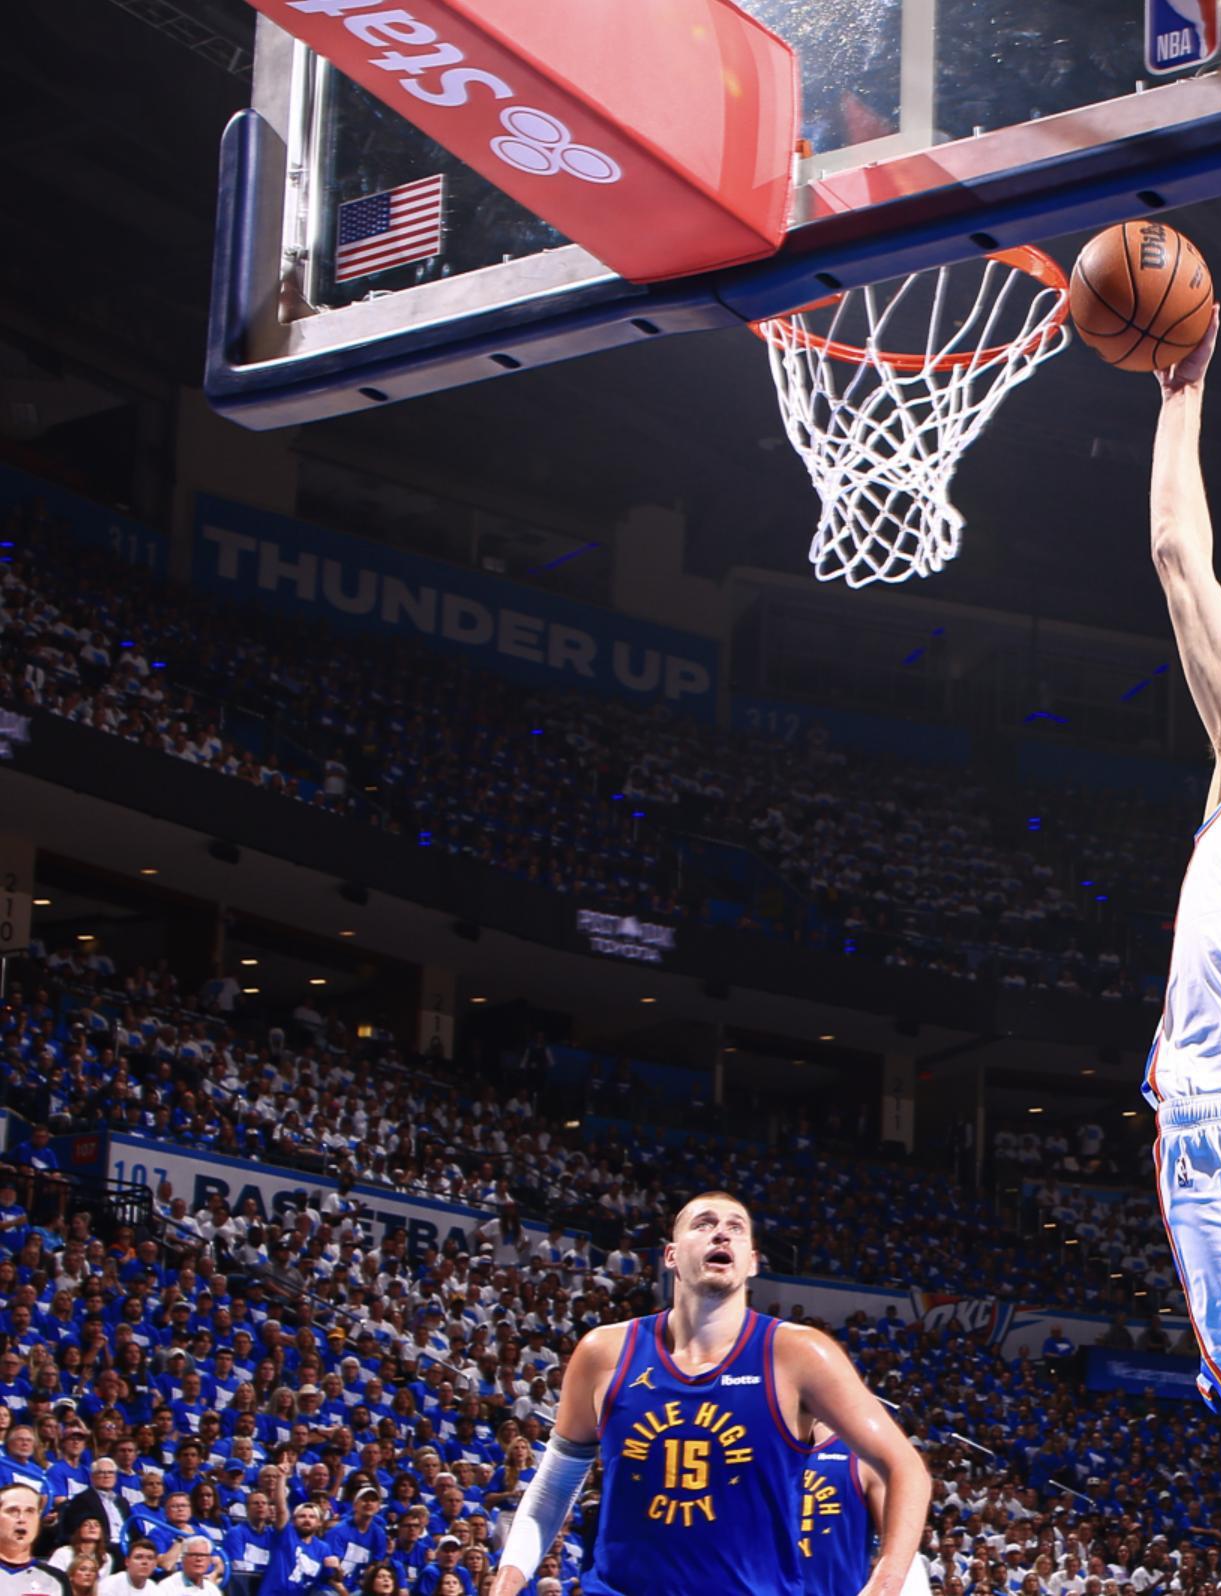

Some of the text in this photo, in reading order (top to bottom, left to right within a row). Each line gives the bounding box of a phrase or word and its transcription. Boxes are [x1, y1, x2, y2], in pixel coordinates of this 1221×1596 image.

[1157, 27, 1192, 63] NBA
[202, 524, 711, 700] THUNDER UP
[0, 872, 18, 942] 210
[114, 1160, 168, 1196] 107
[622, 1401, 754, 1464] MILE HIGH
[663, 1438, 711, 1491] 15
[648, 1494, 717, 1527] CITY
